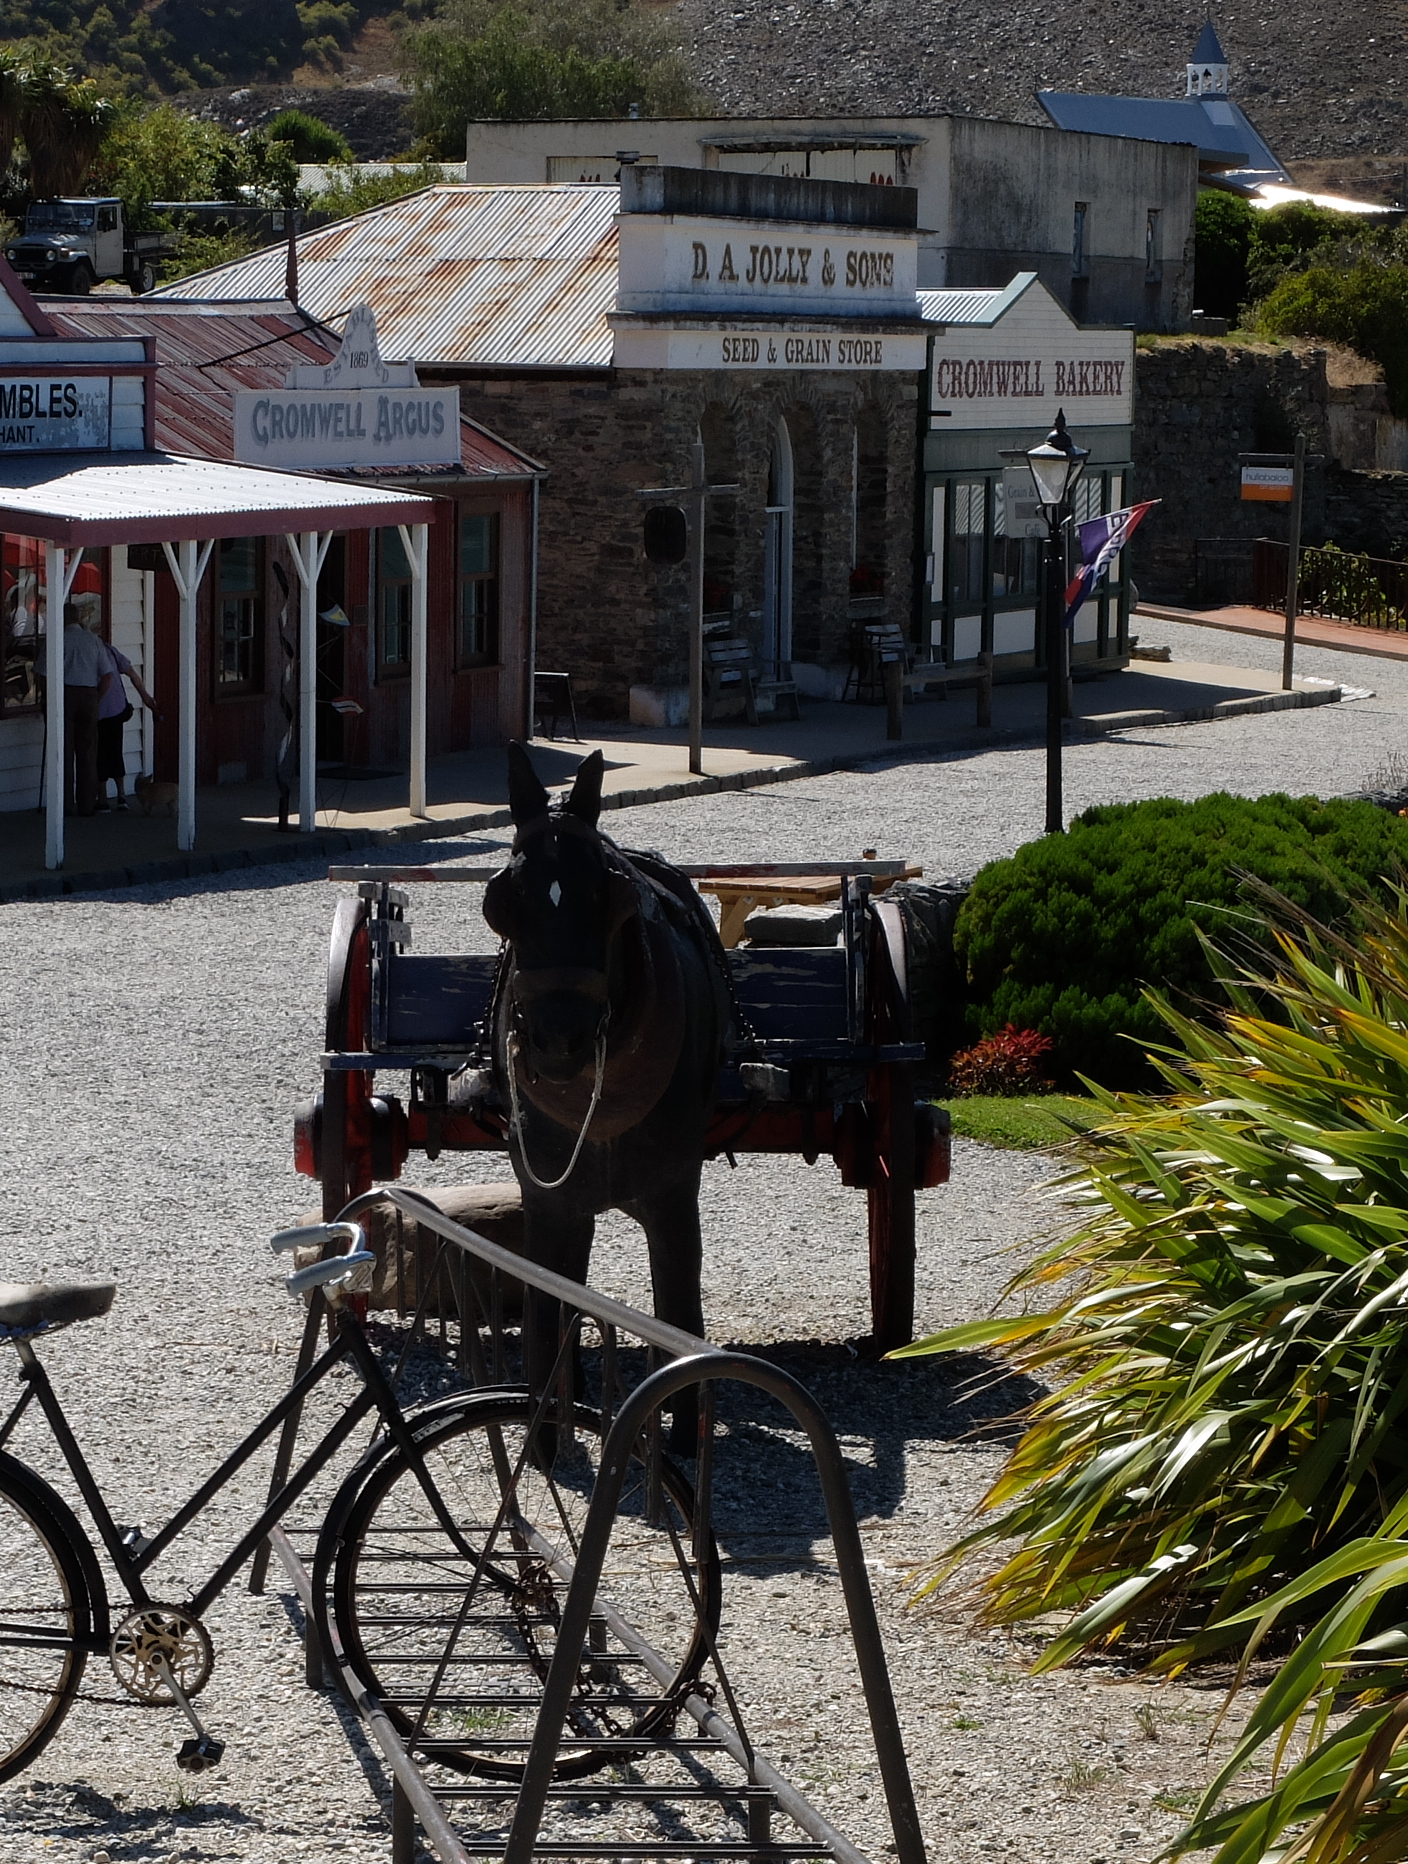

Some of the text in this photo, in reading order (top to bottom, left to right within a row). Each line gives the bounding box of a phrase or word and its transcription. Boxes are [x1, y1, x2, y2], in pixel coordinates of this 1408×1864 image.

[691, 241, 894, 288] D. A. JOLLY & SONS
[350, 351, 369, 369] 1869
[722, 337, 883, 365] SEED & GRAIN STORE
[937, 358, 1125, 399] CROMWELL BAKERY
[251, 395, 445, 446] CROMWELL ARGUS
